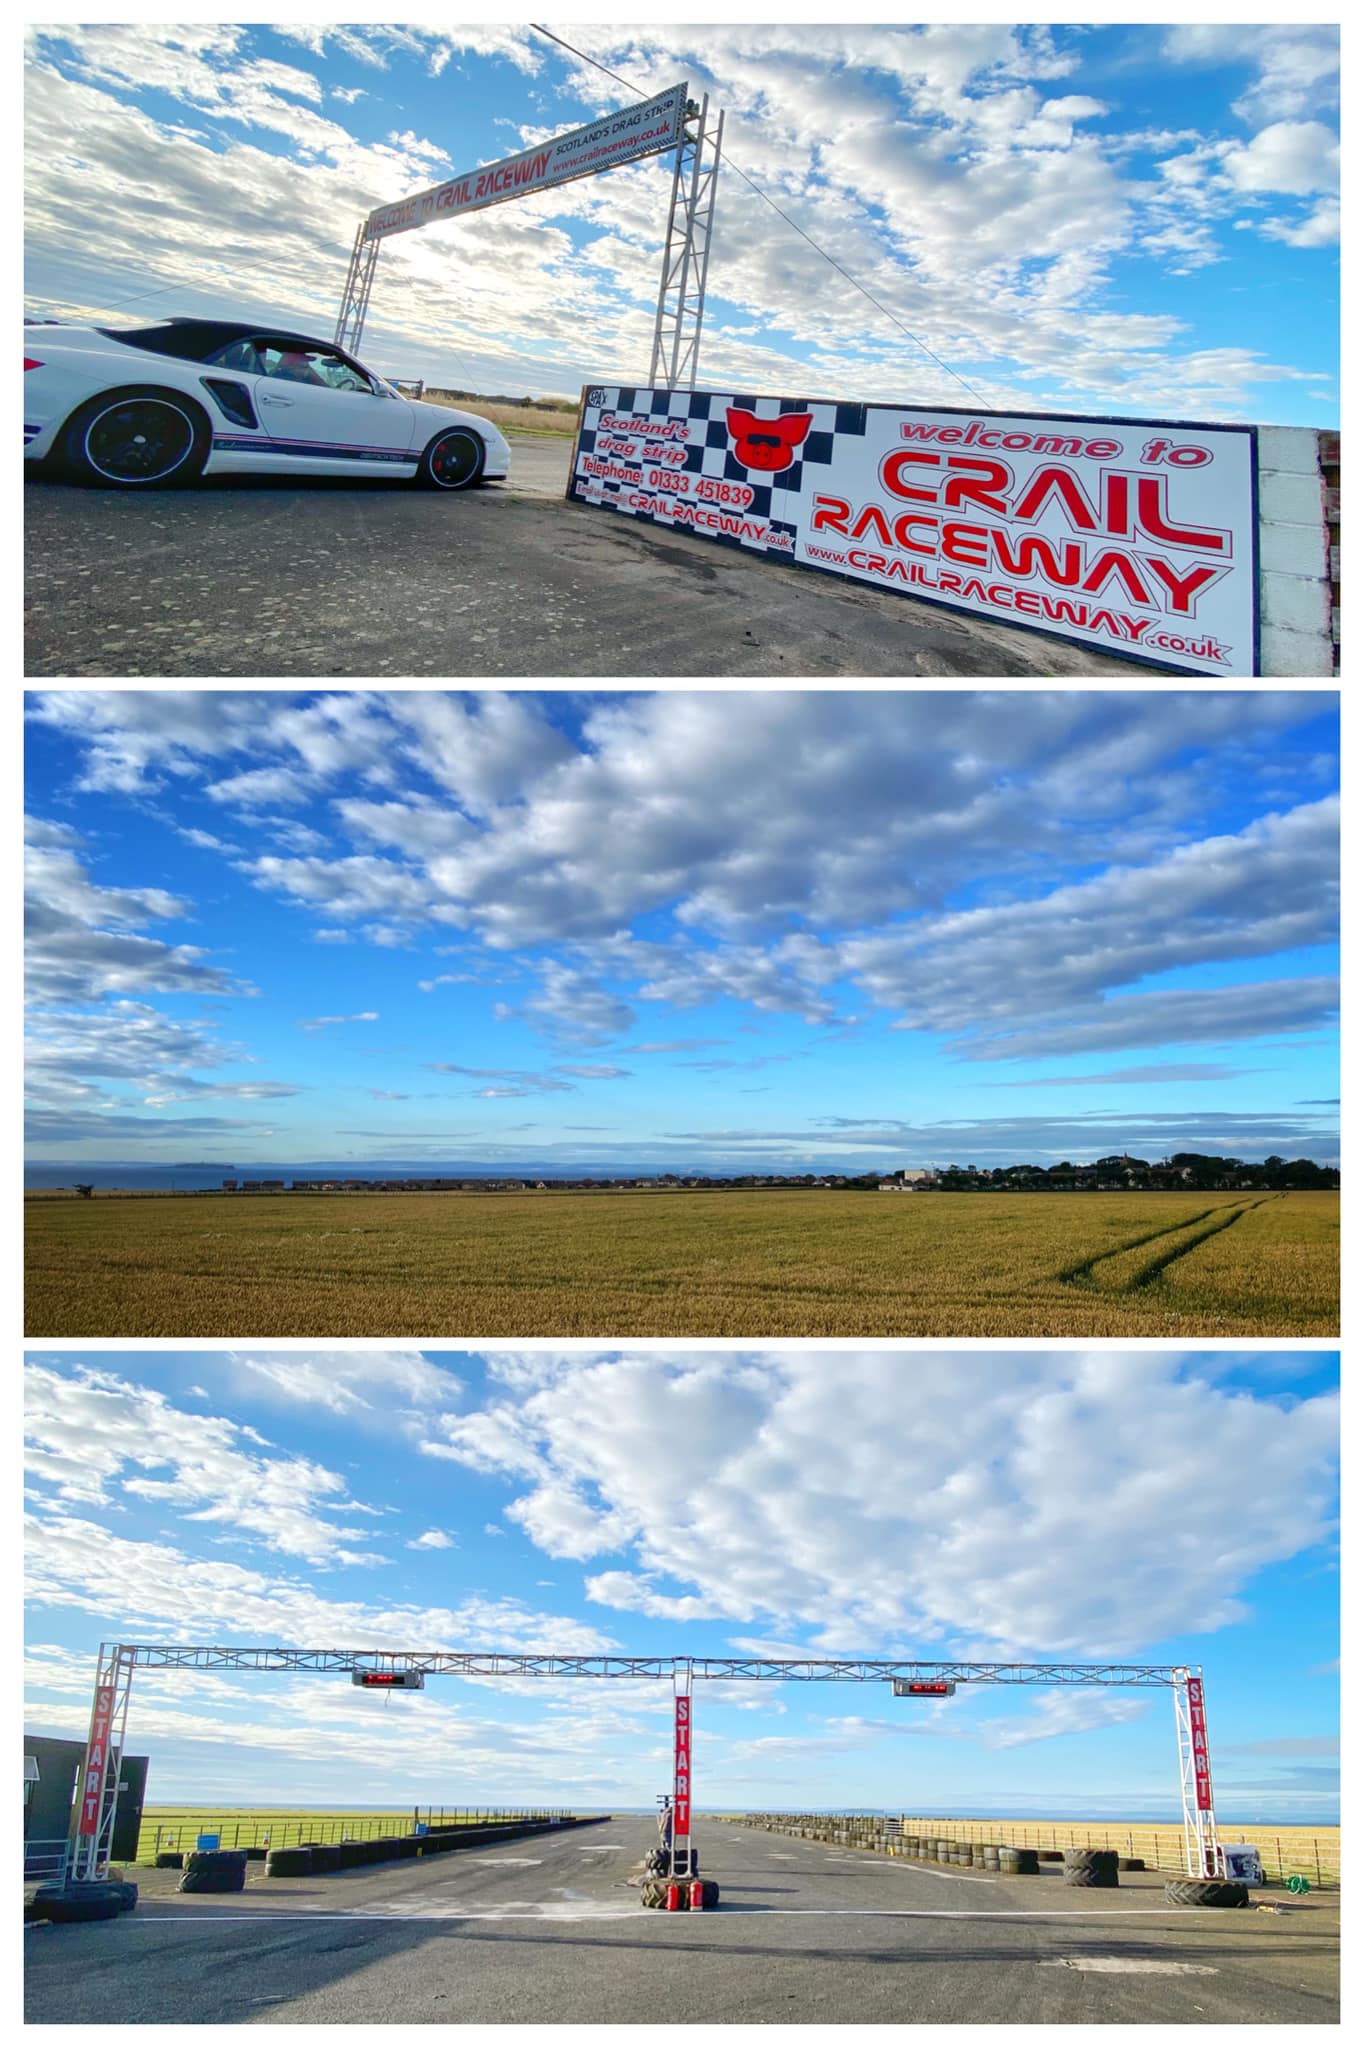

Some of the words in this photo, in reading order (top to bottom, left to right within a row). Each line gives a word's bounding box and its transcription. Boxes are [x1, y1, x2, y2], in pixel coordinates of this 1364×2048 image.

[552, 120, 671, 173] www.crailraceway.co.uk
[556, 126, 611, 155] SCOTLAND'S
[612, 114, 641, 134] DRAG
[369, 201, 417, 234] WELCOME
[421, 196, 434, 215] TO
[436, 181, 473, 212] CRAIL
[475, 150, 553, 199] RACEWAY
[597, 436, 638, 459] drag
[642, 443, 687, 464] strip
[600, 415, 690, 439] Scotland's
[901, 422, 1122, 460] welcome
[1143, 438, 1212, 468] to
[582, 456, 645, 484] Telephone:
[649, 469, 690, 493] 01333
[695, 478, 754, 507] 451839
[881, 449, 1228, 553] CRAIL
[812, 494, 1227, 615] RACEWAY
[805, 542, 1229, 664] www.CRAILRACEWAY.co.uk
[87, 1690, 111, 1821] START
[676, 1700, 688, 1822] START
[1189, 1682, 1208, 1799] START
